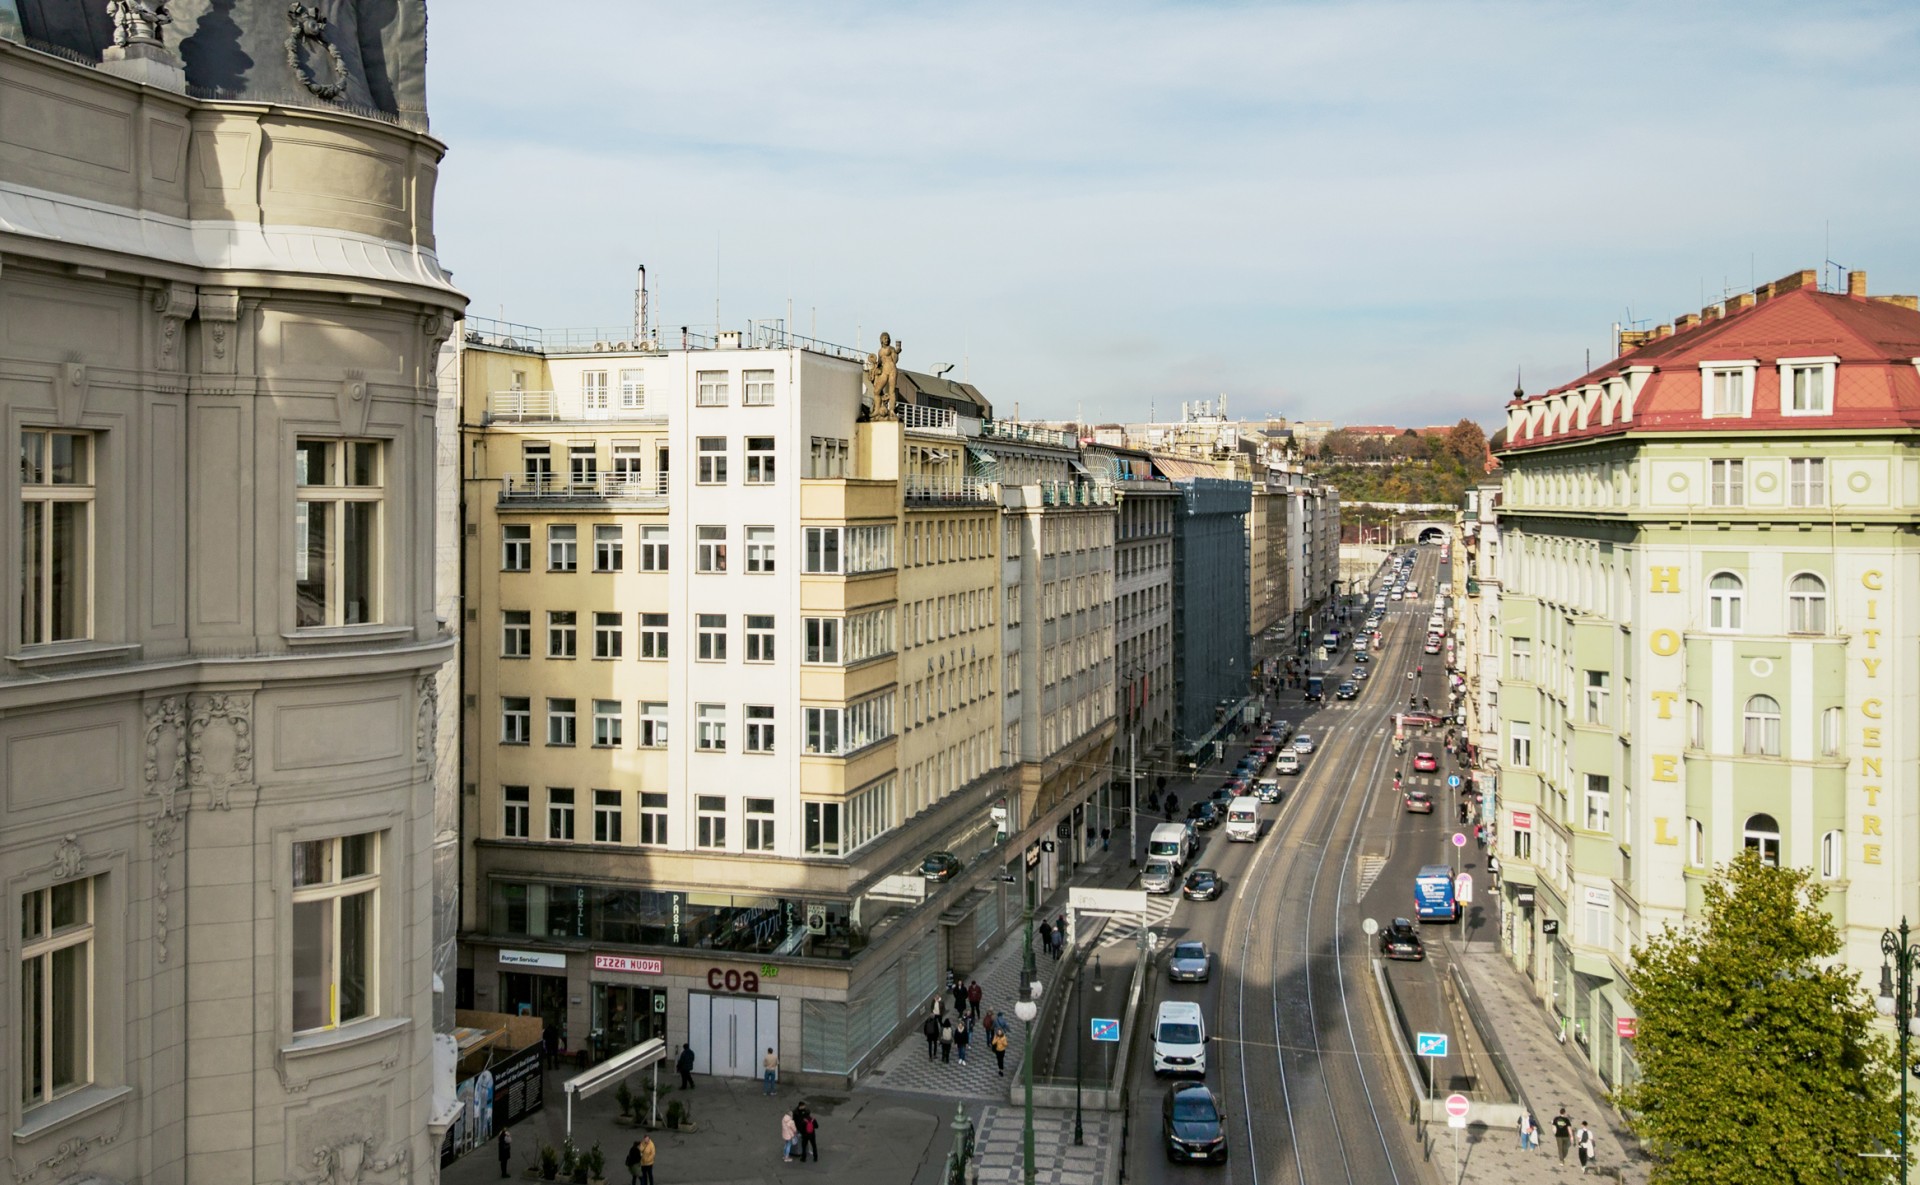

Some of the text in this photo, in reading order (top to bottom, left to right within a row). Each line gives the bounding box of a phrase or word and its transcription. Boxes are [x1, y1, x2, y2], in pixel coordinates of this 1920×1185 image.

[928, 644, 976, 673] KOTVA
[1649, 566, 1681, 846] HOTEL
[1861, 569, 1883, 865] CITY CENTRE
[596, 957, 660, 971] PIZZA NUOVA
[707, 967, 759, 993] coa
